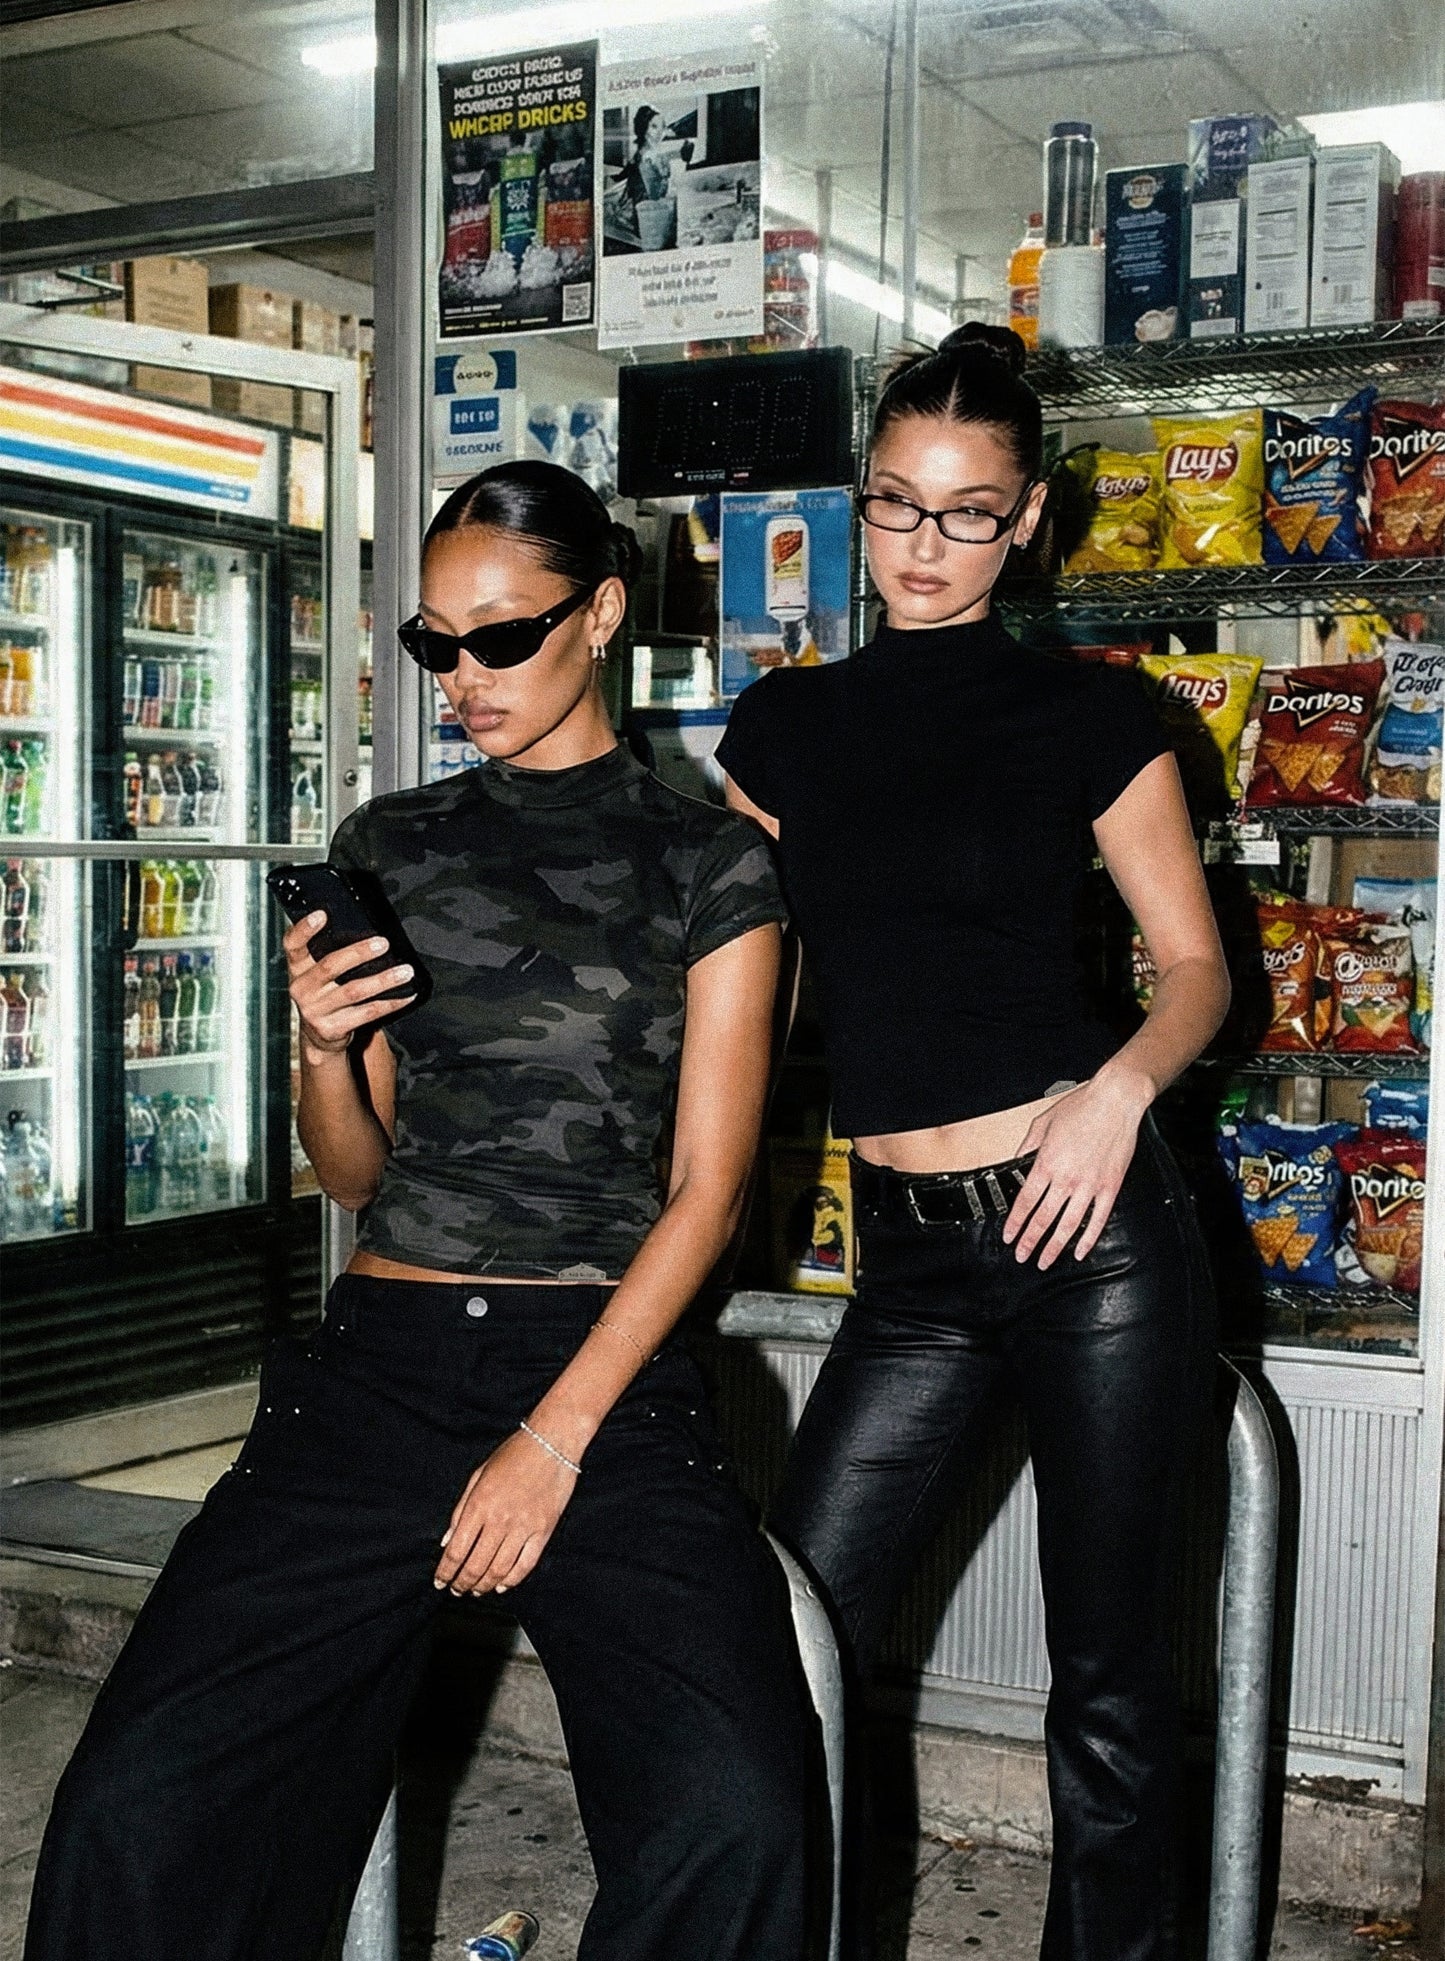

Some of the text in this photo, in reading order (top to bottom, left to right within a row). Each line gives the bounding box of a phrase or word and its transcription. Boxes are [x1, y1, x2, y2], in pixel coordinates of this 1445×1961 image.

[1265, 434, 1352, 462] Doritos
[1369, 429, 1445, 460] Dorito
[1268, 692, 1364, 714] Doritos
[1267, 1162, 1325, 1186] ritos
[1351, 1175, 1426, 1200] Dorito
